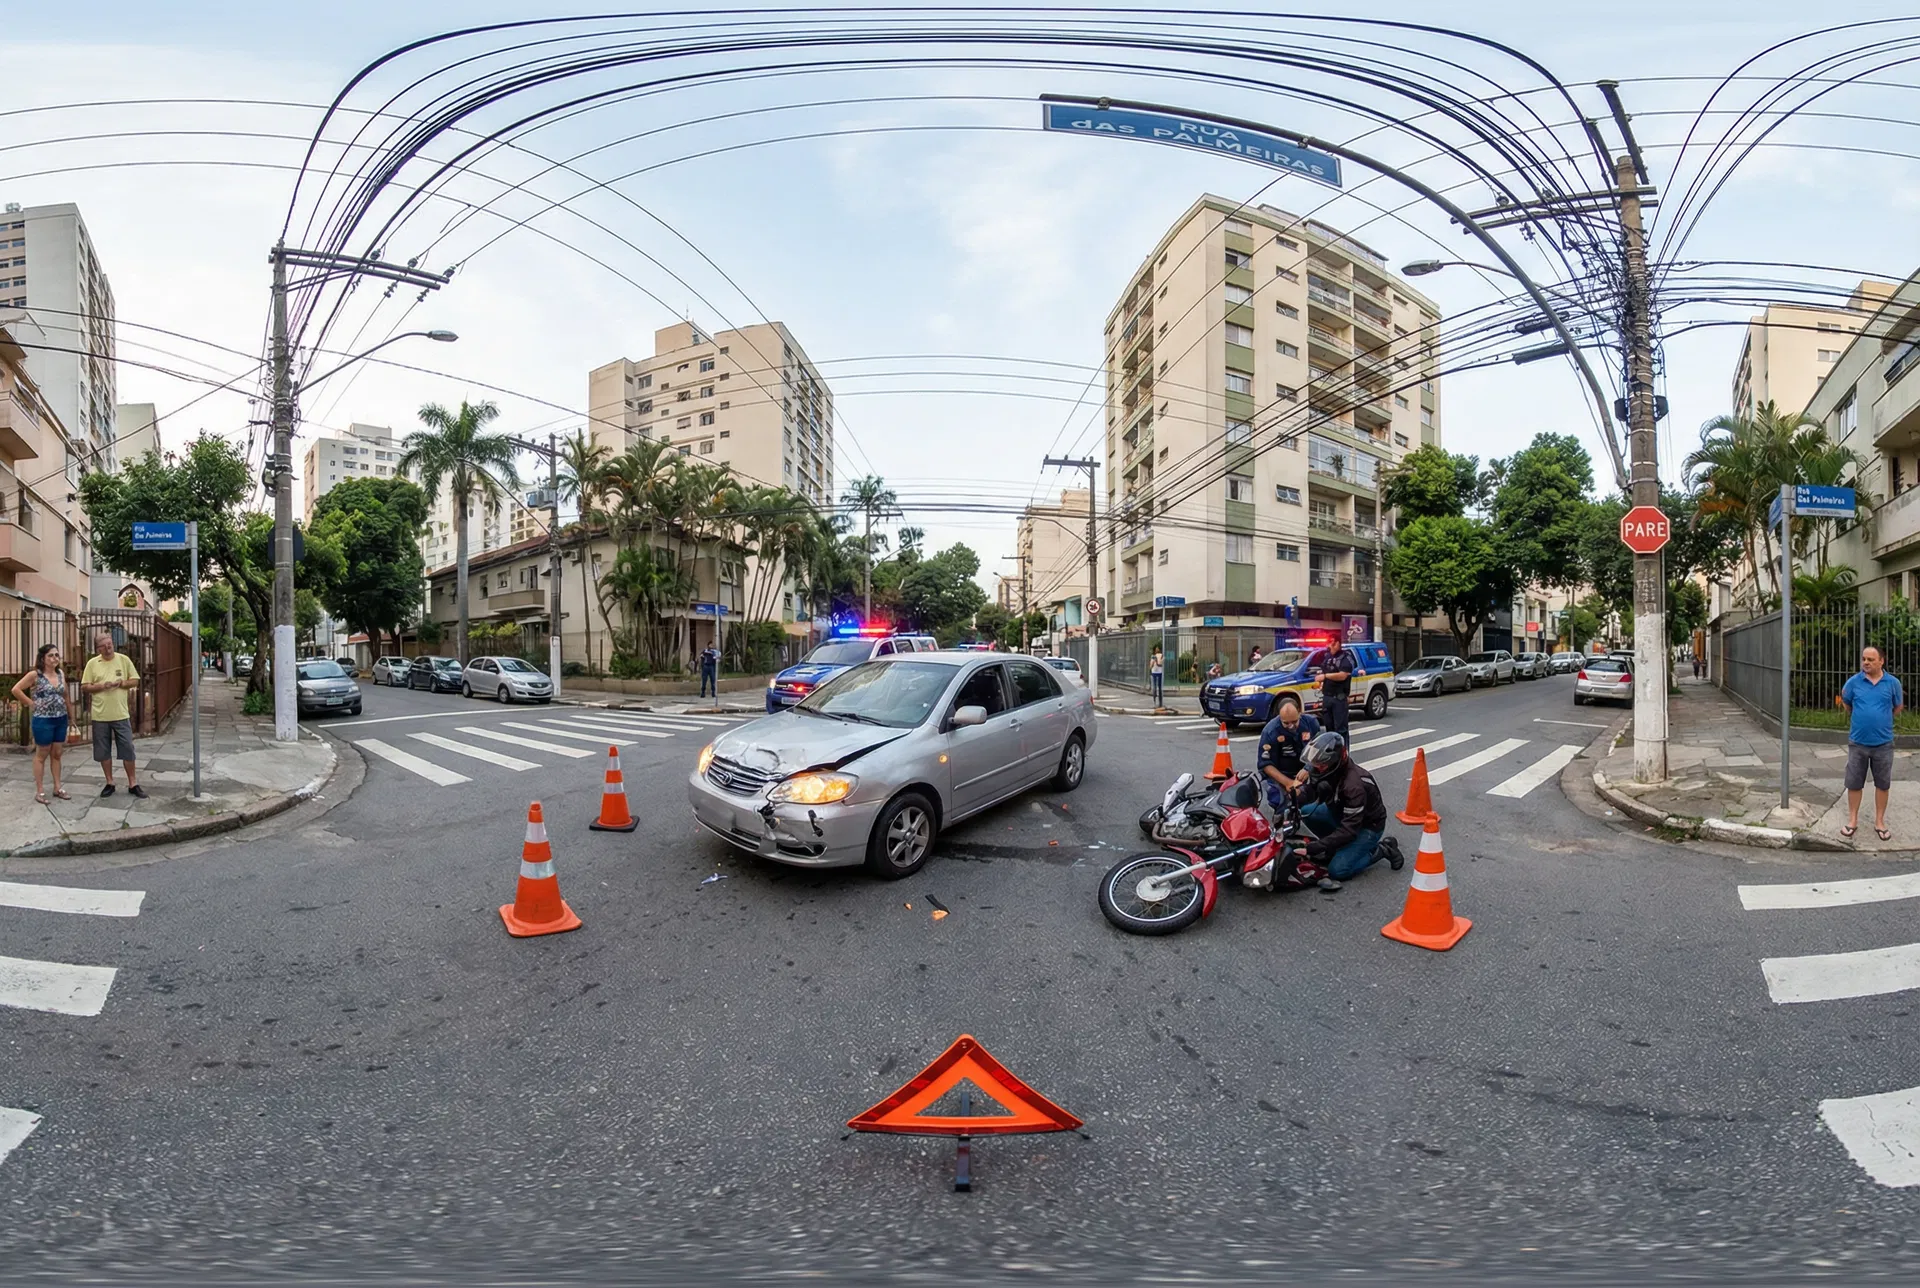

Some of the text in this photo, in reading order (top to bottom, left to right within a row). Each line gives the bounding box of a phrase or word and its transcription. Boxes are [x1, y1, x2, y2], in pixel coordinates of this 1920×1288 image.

[1180, 122, 1239, 141] RUA
[1153, 127, 1325, 176] PALMEIRAS
[1625, 522, 1666, 537] PARE
